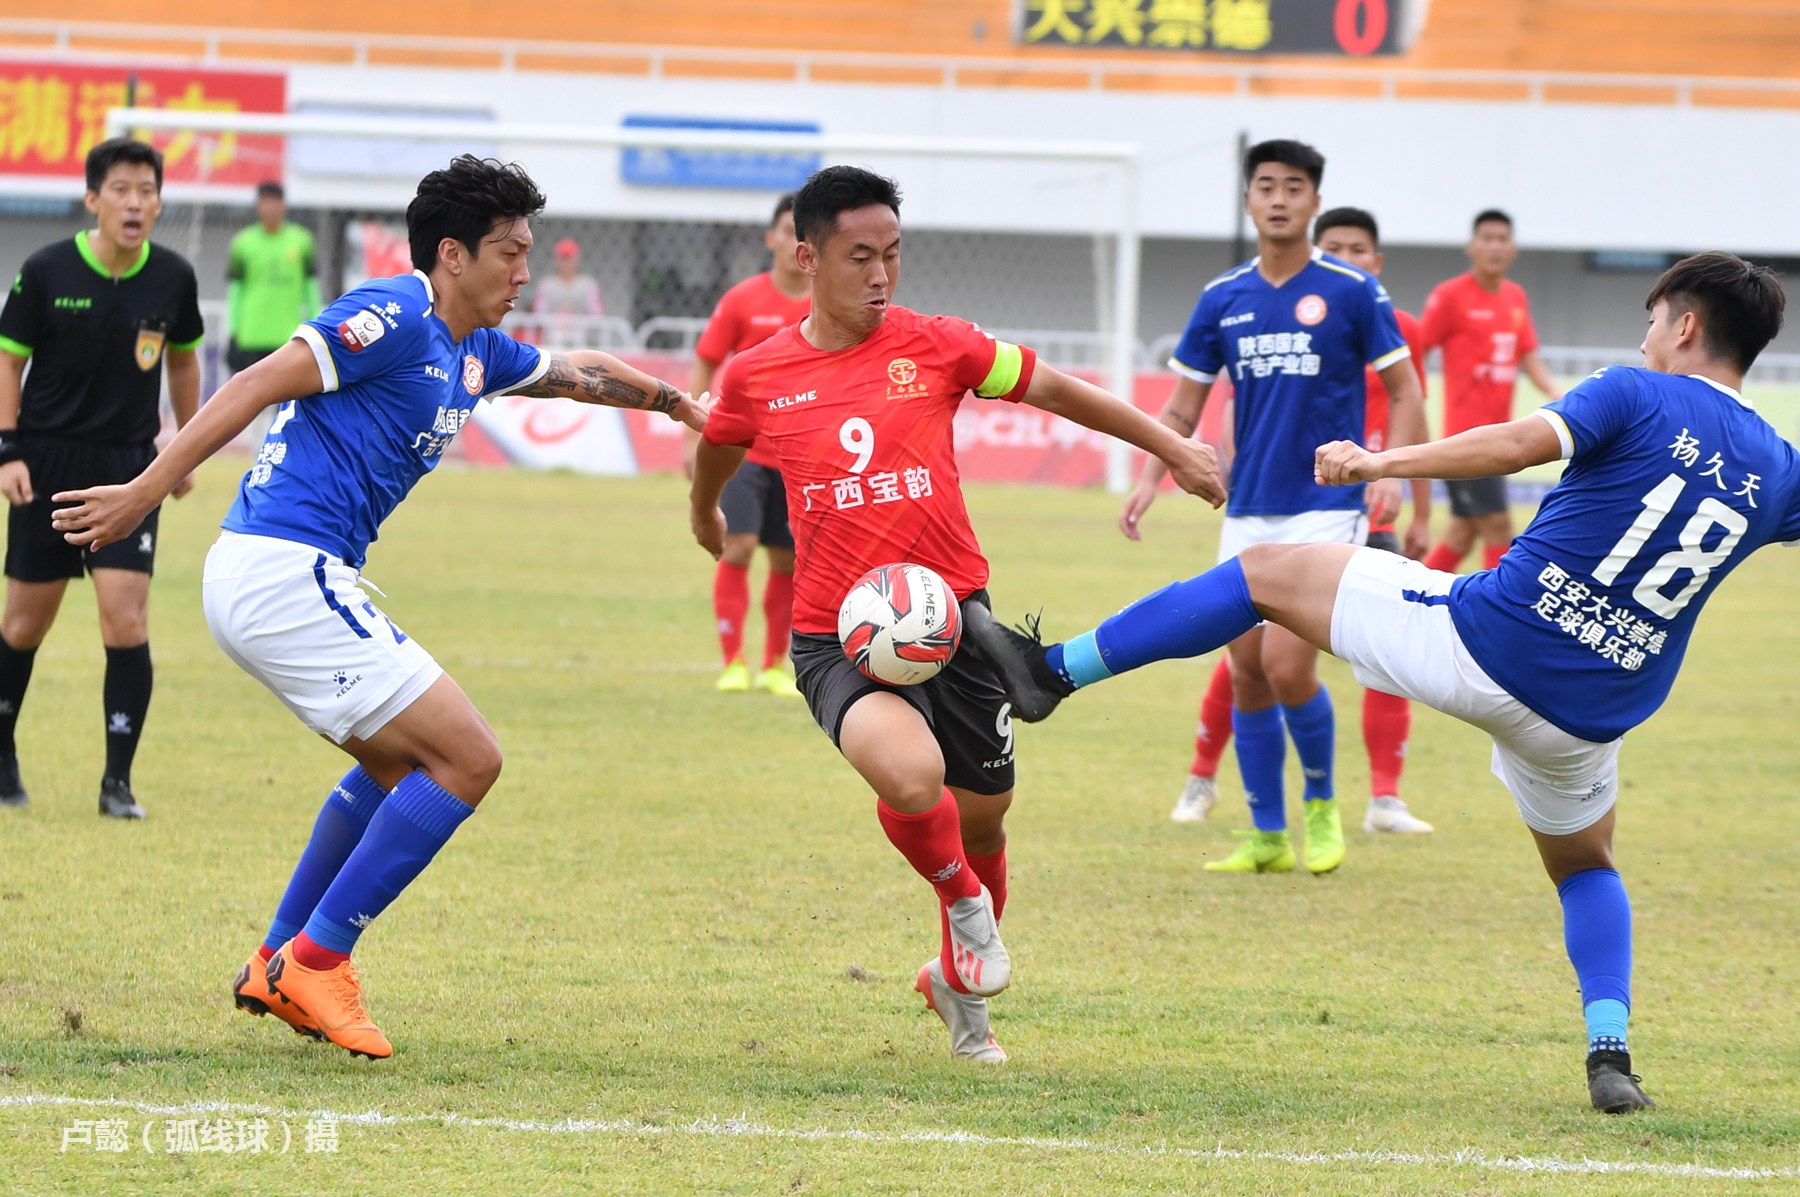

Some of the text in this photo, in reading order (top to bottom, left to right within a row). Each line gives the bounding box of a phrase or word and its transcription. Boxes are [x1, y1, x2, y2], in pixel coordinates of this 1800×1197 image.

[1333, 0, 1388, 55] 0
[369, 303, 399, 330] KELME
[1235, 353, 1321, 380] 广告产业园
[1237, 331, 1313, 357] 陕西国家
[768, 390, 817, 411] KELME
[839, 416, 875, 474] 9
[1668, 427, 1762, 509] 杨久天
[802, 465, 934, 512] 广西宝韵
[1590, 472, 1749, 620] 18
[916, 567, 936, 616] KELME
[1537, 561, 1668, 656] 西安大兴崇德
[1530, 591, 1647, 672] 足球俱乐部
[336, 674, 363, 698] KELME
[995, 702, 1013, 754] 9
